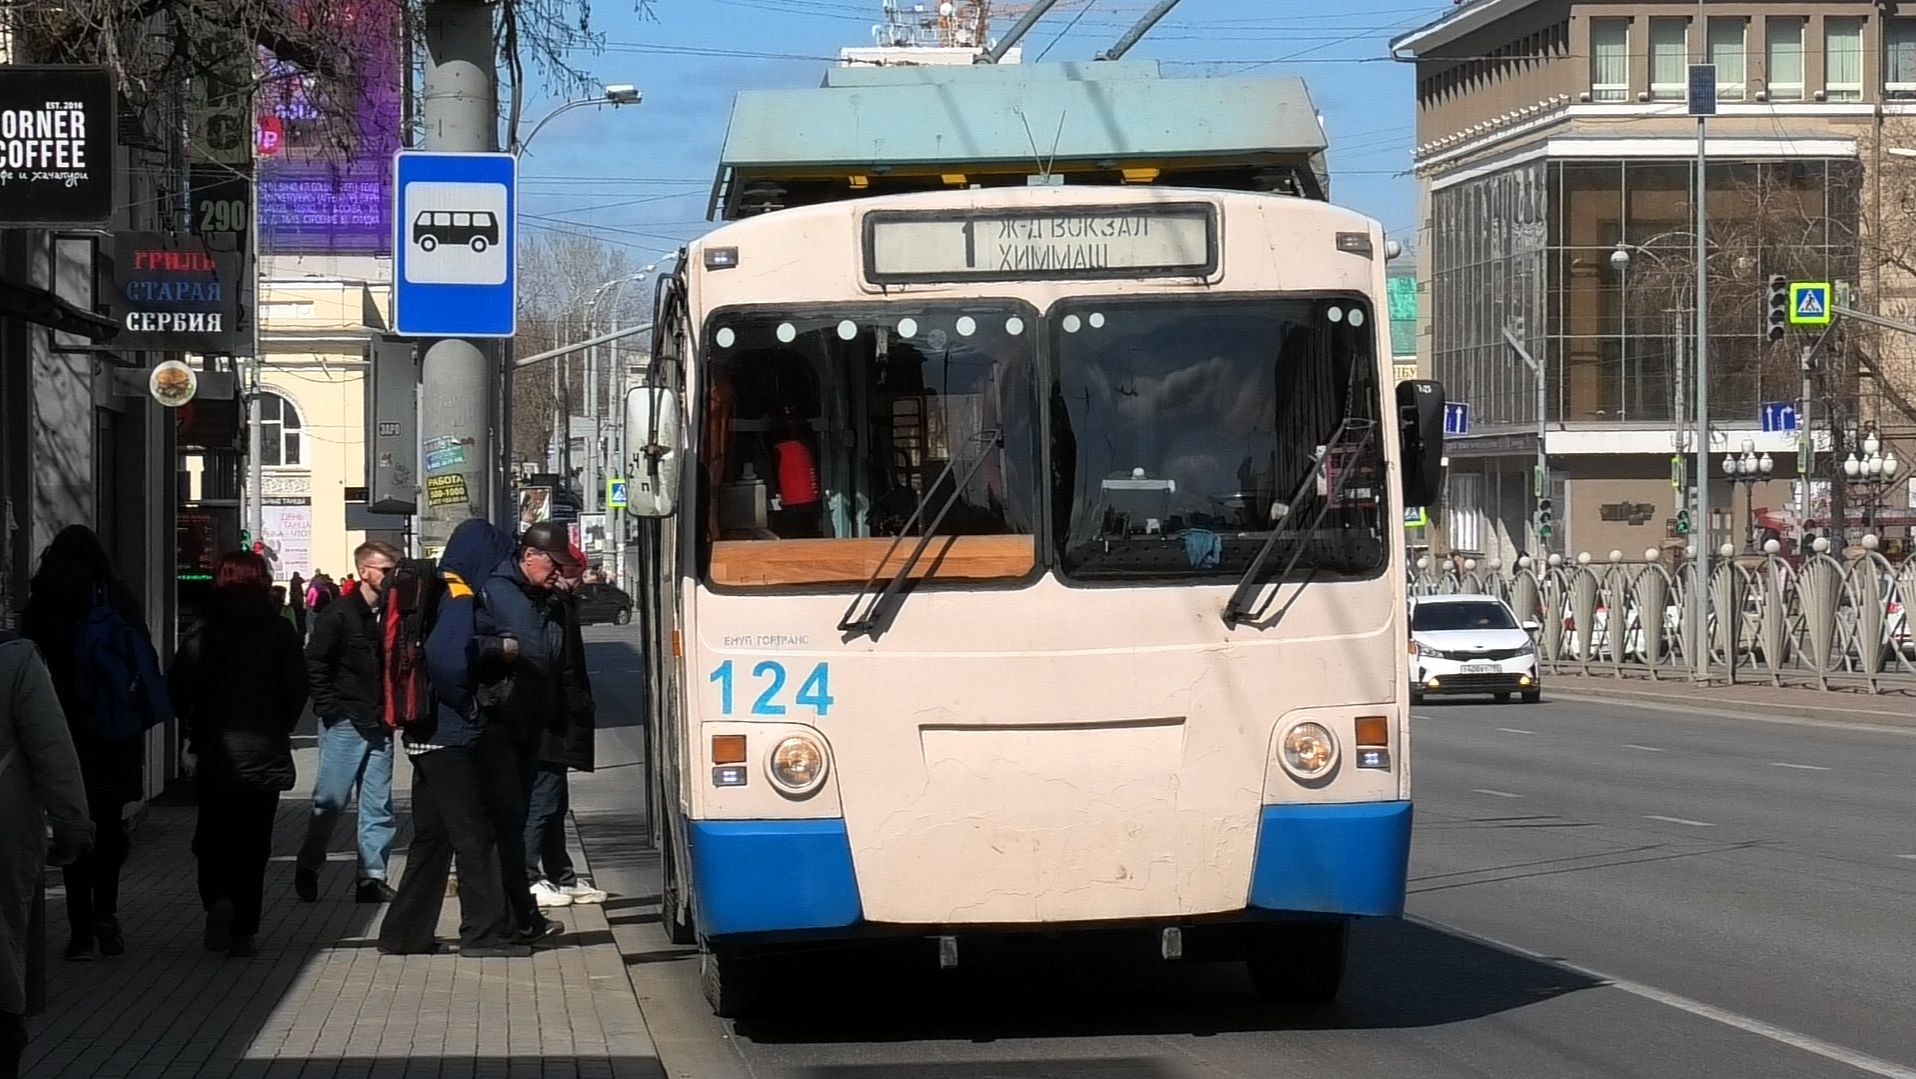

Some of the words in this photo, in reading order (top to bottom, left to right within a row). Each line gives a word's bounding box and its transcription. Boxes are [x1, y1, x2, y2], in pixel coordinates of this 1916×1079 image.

[2, 110, 86, 138] ORNER
[31, 171, 88, 188] хачапури
[200, 200, 245, 232] 290
[1050, 215, 1150, 238] ВОКЗАЛ
[962, 220, 975, 268] 1
[134, 250, 216, 272] ГРИЛЬ
[998, 244, 1109, 271] ХИММАШ
[126, 280, 222, 301] СТАРАЯ
[126, 311, 223, 332] СЕРБИЯ
[428, 475, 464, 487] РАБОТА
[710, 660, 834, 715] 124
